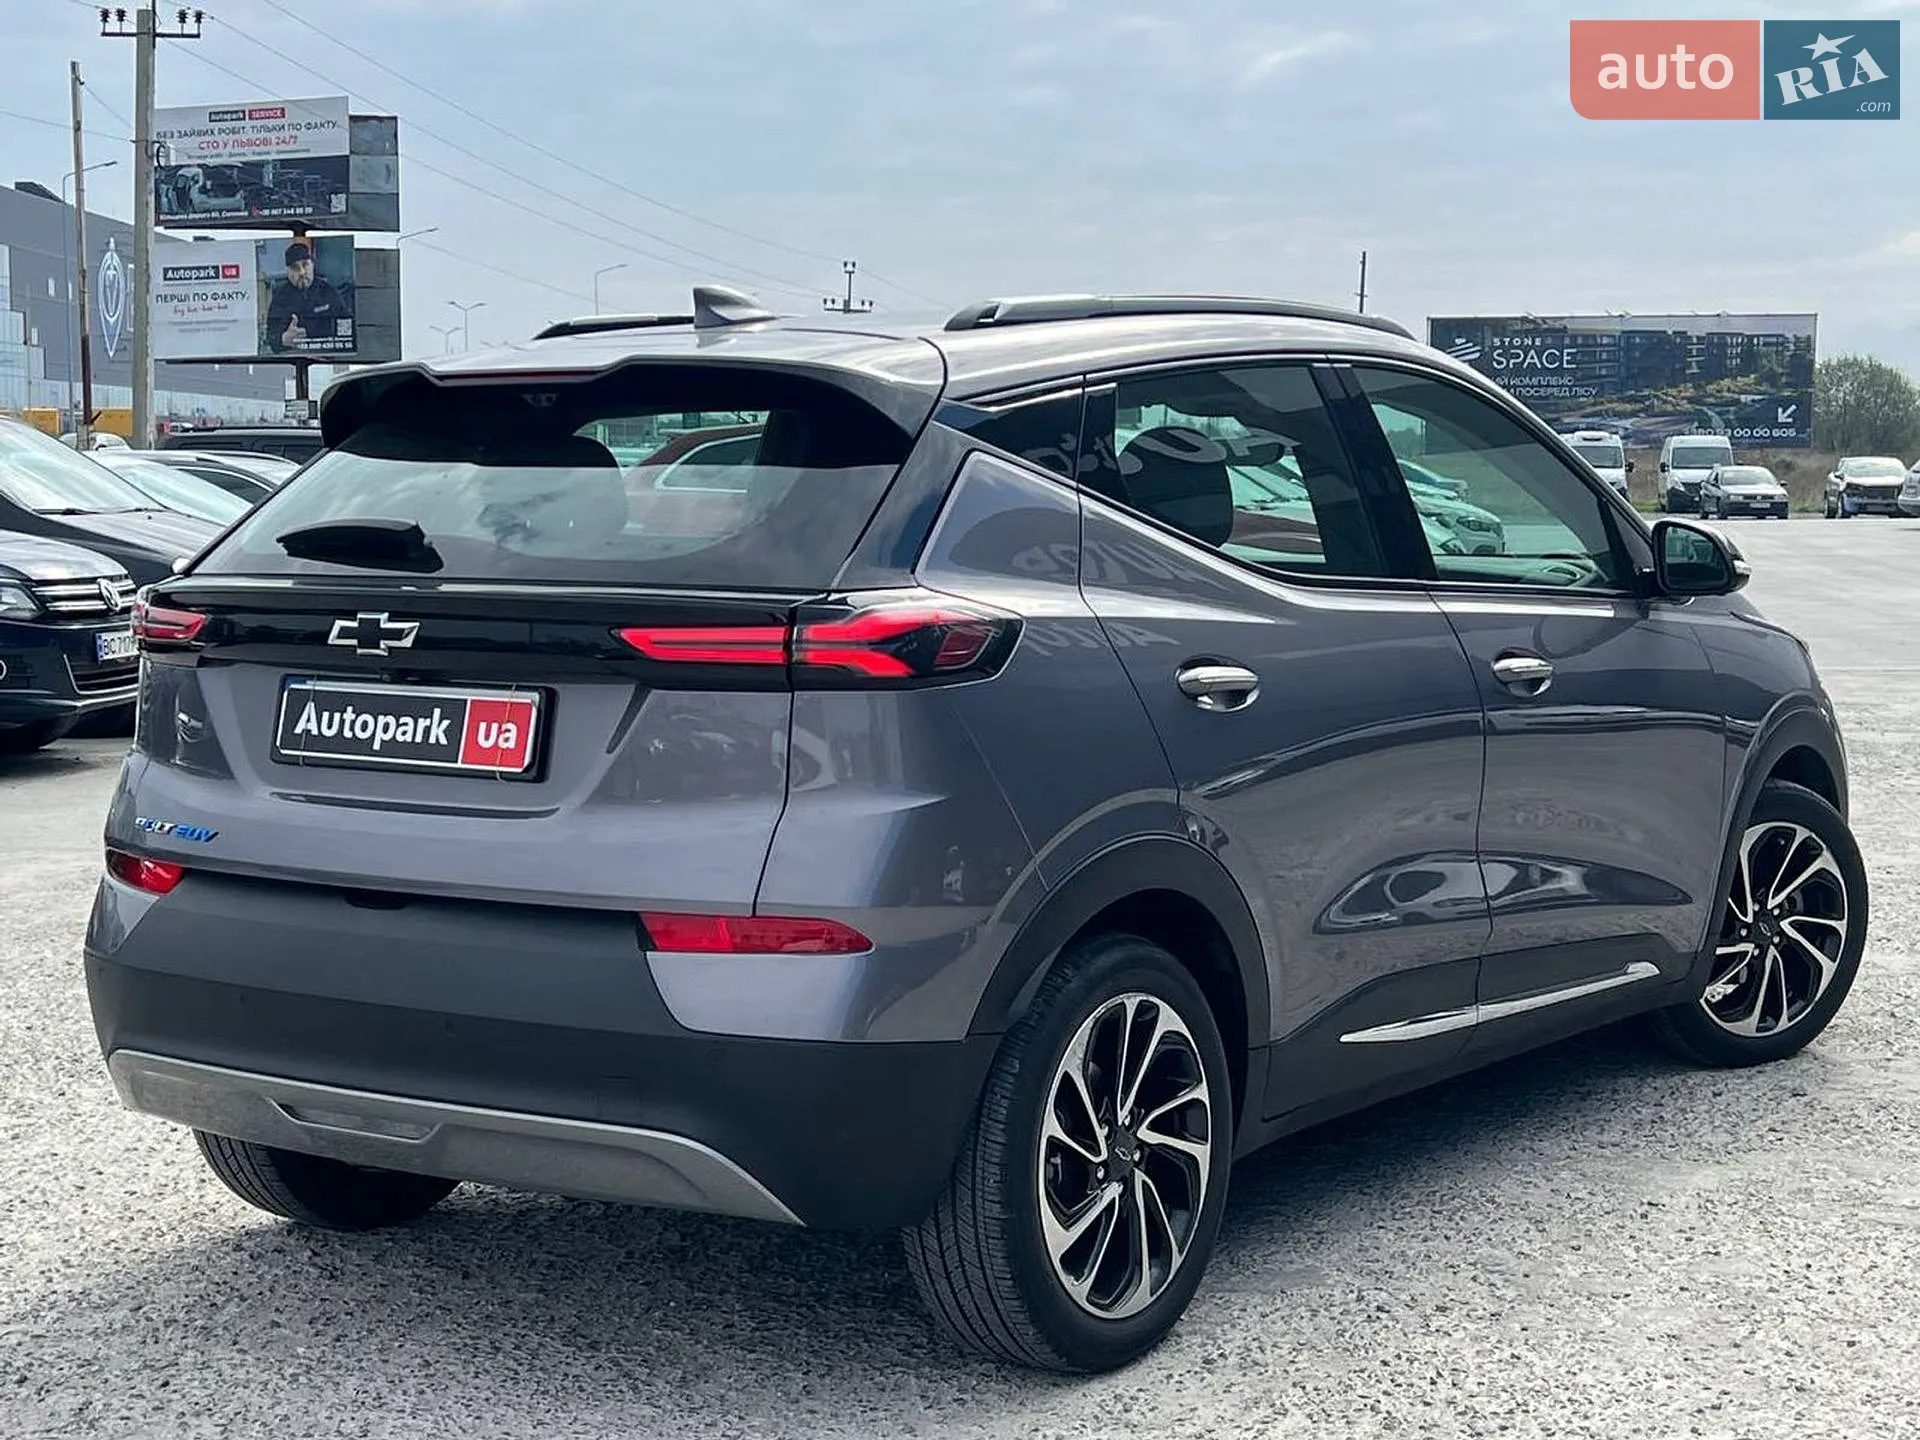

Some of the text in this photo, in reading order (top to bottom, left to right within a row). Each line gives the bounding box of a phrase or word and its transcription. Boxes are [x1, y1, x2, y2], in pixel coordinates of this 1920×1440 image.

[288, 122, 302, 132] ПО
[198, 135, 298, 151] СТО У ЛЬВОВІ 24/7
[166, 266, 238, 280] Autopark ua
[155, 293, 191, 304] ПЕРШІ
[192, 292, 209, 302] ПО
[1492, 336, 1542, 347] STONE
[1492, 348, 1578, 370] SPACE
[1510, 376, 1575, 386] КОМПЛЕКС
[1516, 387, 1570, 397] ПОСЕРЕД
[1733, 428, 1751, 438] 00
[1753, 428, 1770, 438] 00
[294, 701, 518, 750] Autopark ua
